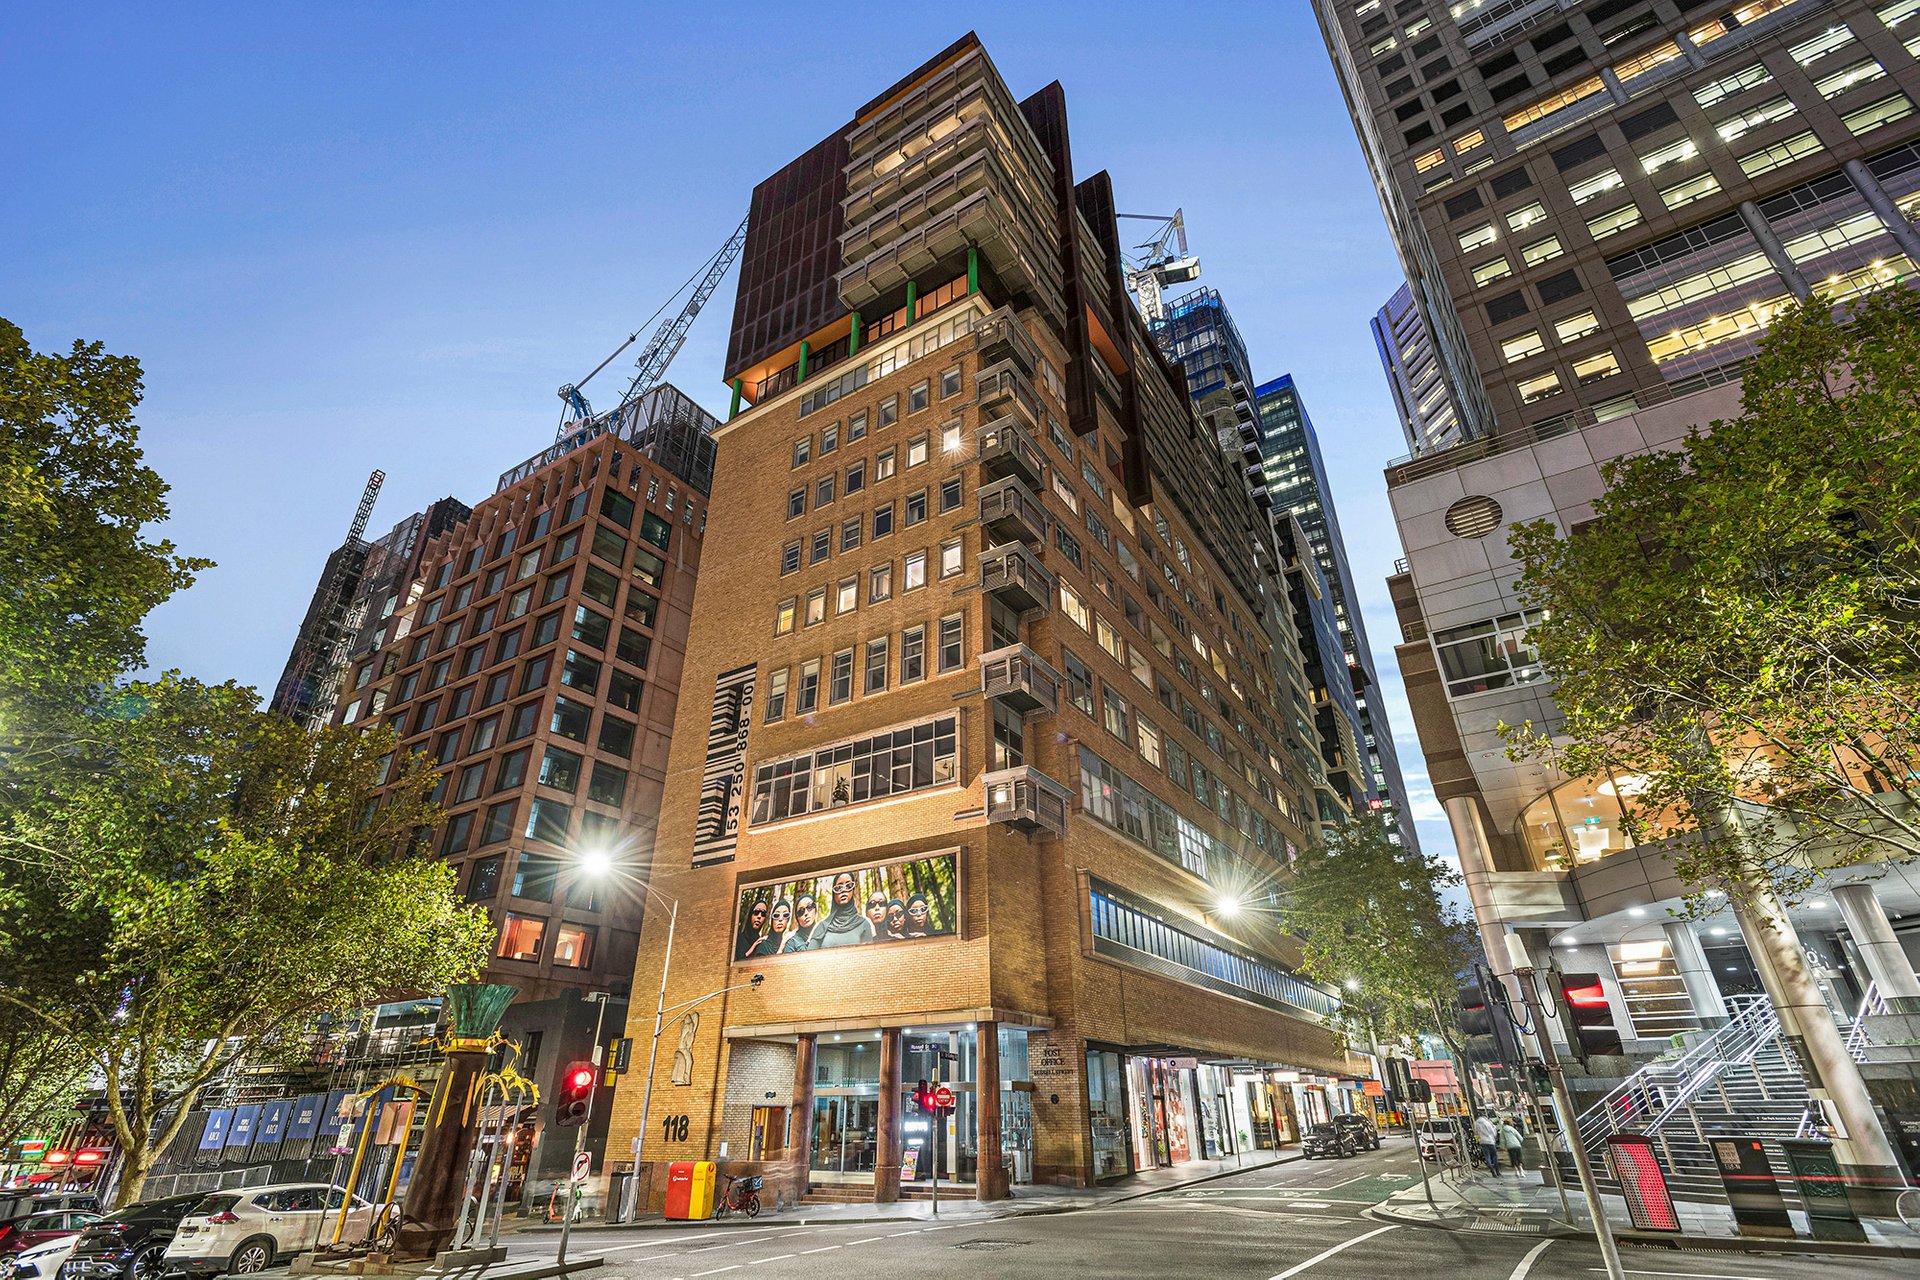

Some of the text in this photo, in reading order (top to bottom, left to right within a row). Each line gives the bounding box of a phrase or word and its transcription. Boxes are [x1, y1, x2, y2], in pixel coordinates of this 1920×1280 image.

[731, 762, 744, 797] 250
[727, 805, 740, 830] 53
[1041, 1058, 1065, 1066] OFFICE
[1044, 1049, 1061, 1057] POST
[662, 1115, 690, 1142] 118
